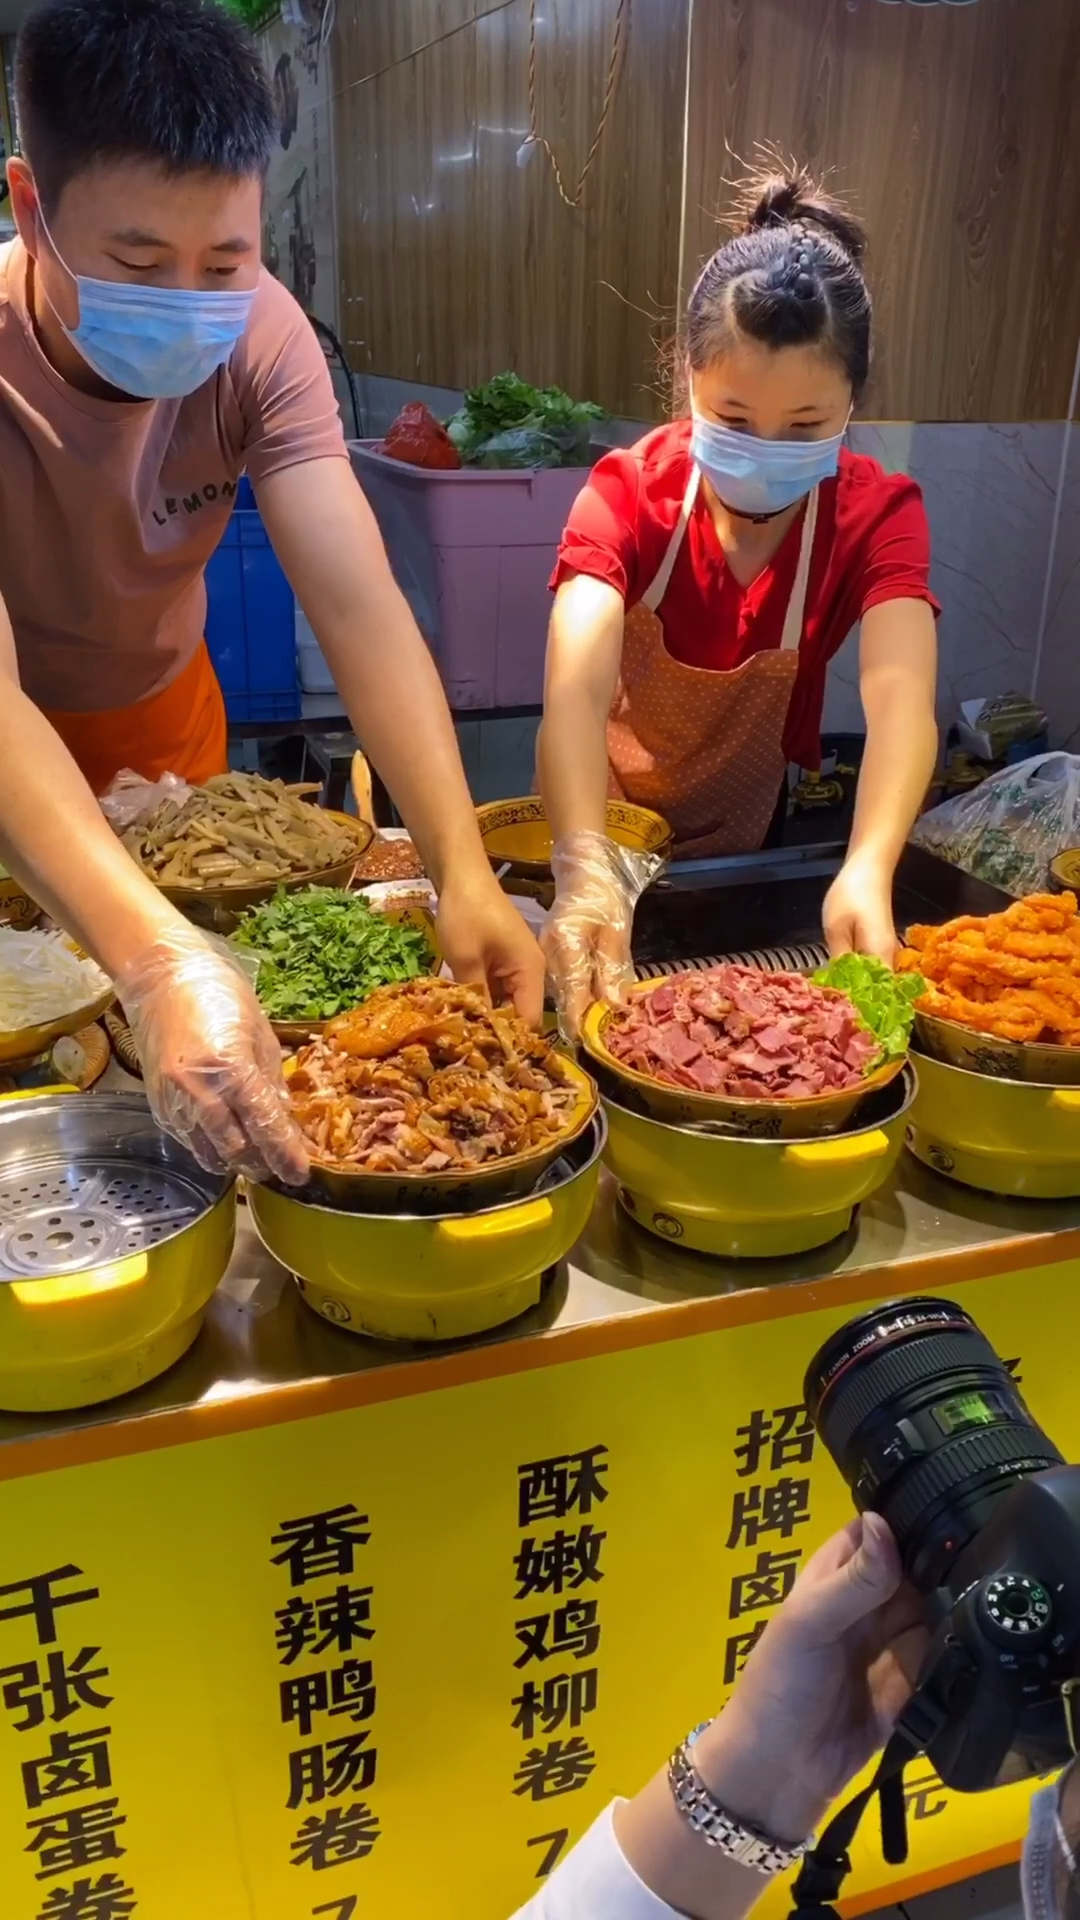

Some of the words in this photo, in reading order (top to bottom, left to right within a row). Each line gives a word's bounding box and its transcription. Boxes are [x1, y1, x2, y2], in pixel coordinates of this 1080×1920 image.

[152, 481, 238, 526] LEMON
[852, 1333, 877, 1353] ZOOM
[0, 1563, 138, 1920] 千张卤蛋卷
[270, 1503, 382, 1871] 香辣鸭肠卷
[511, 1444, 609, 1801] 酥嫩鸡柳卷
